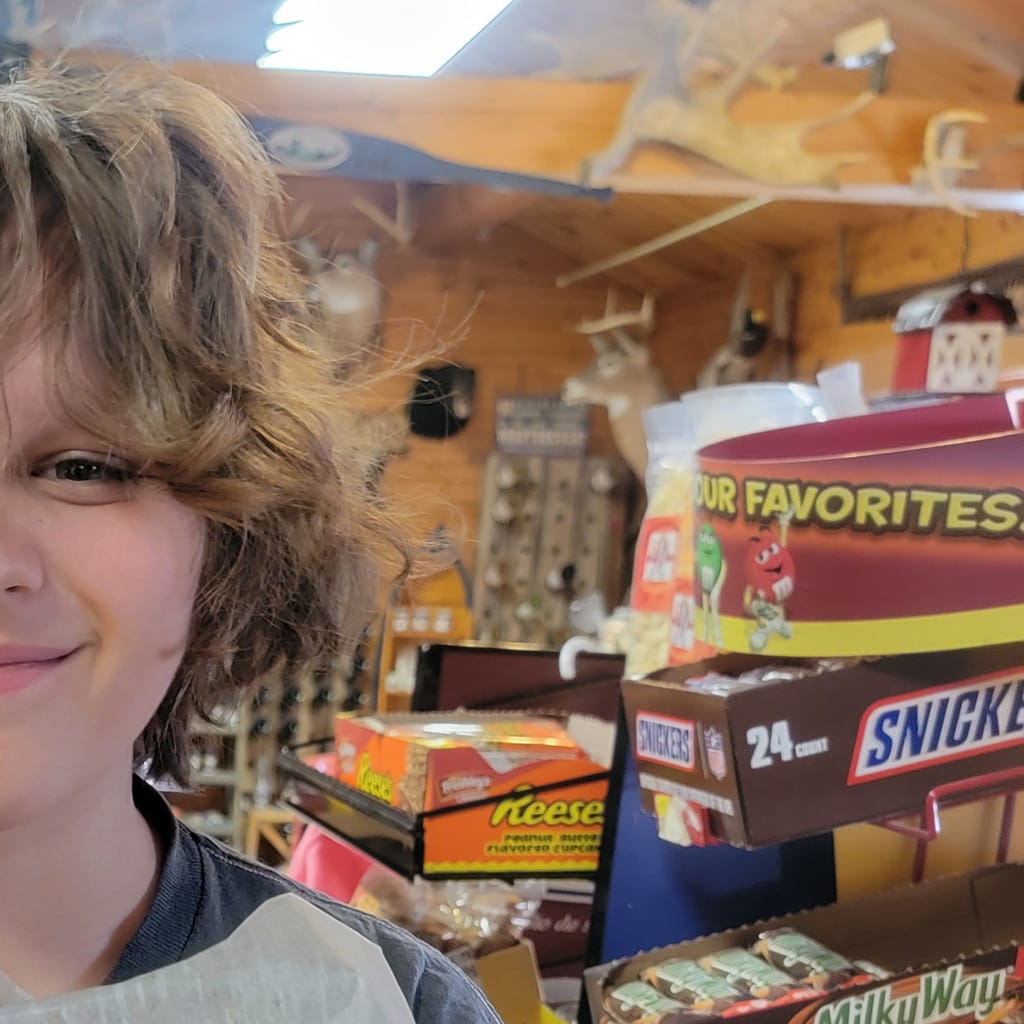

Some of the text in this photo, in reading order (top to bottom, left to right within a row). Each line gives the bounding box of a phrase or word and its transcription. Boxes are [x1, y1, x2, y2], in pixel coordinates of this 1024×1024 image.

[638, 718, 690, 763] SNICKERS
[746, 720, 828, 769] 24 COUNT
[490, 784, 605, 826] Reese
